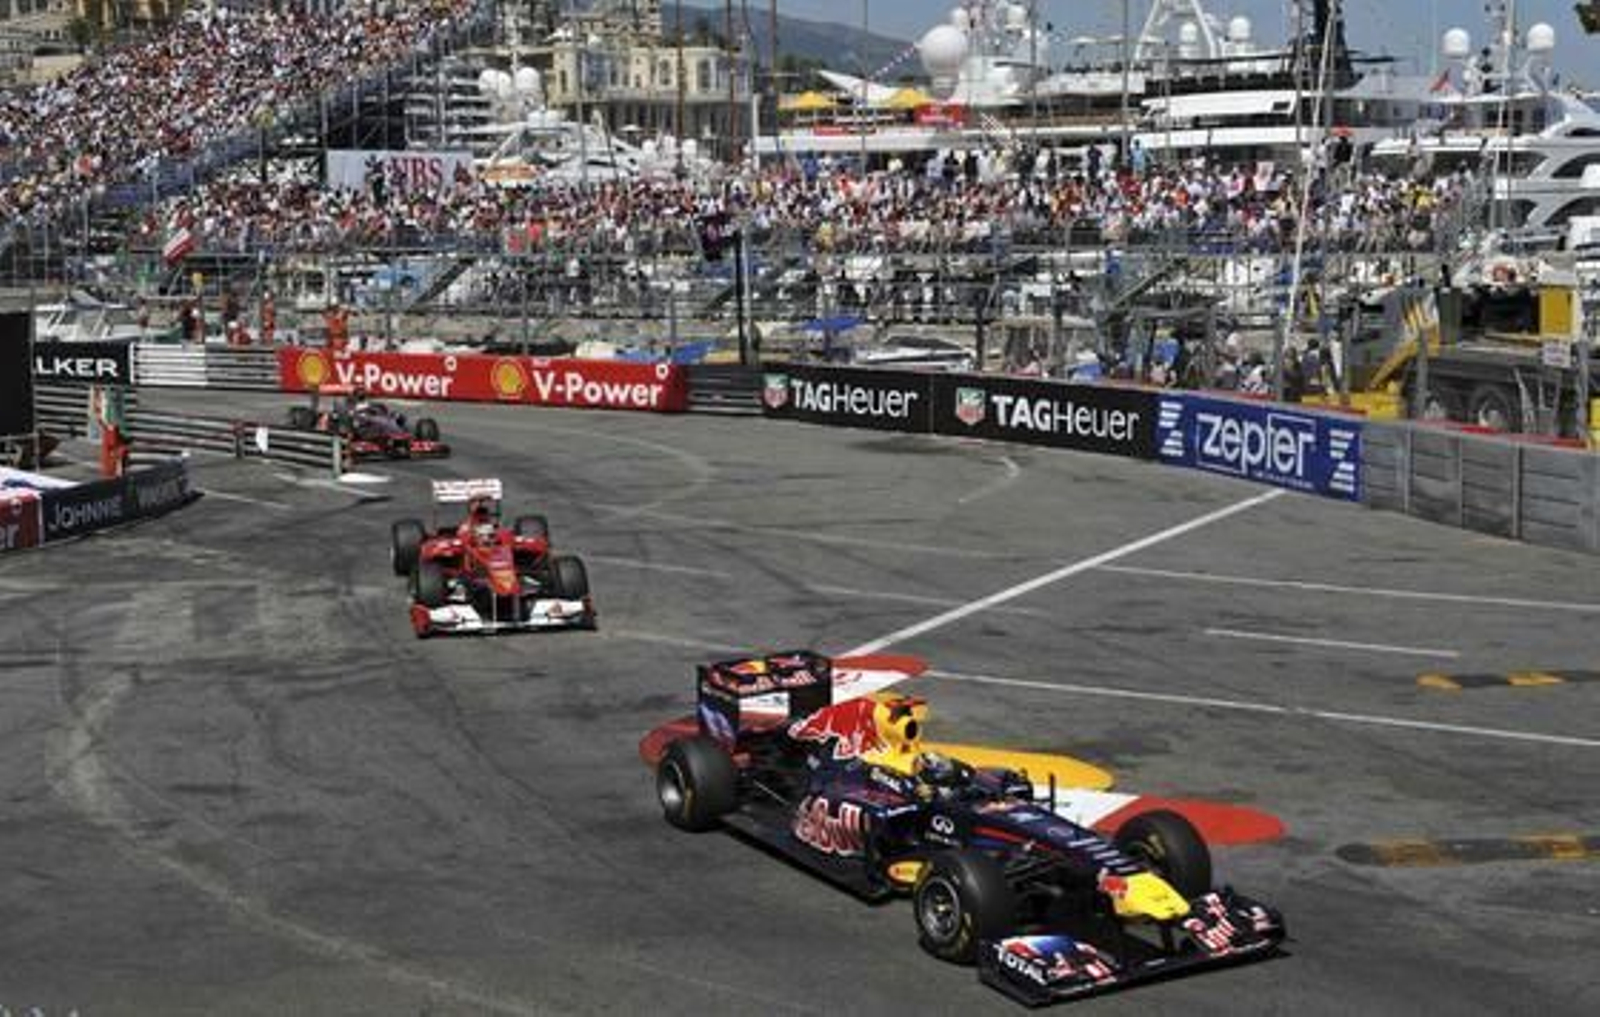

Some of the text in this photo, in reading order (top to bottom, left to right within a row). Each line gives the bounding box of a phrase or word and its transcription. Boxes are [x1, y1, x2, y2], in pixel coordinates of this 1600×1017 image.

[32, 356, 119, 377] LKER
[335, 361, 454, 397] V-Power
[532, 370, 664, 406] V-Power
[992, 943, 1048, 986] TOTAL
